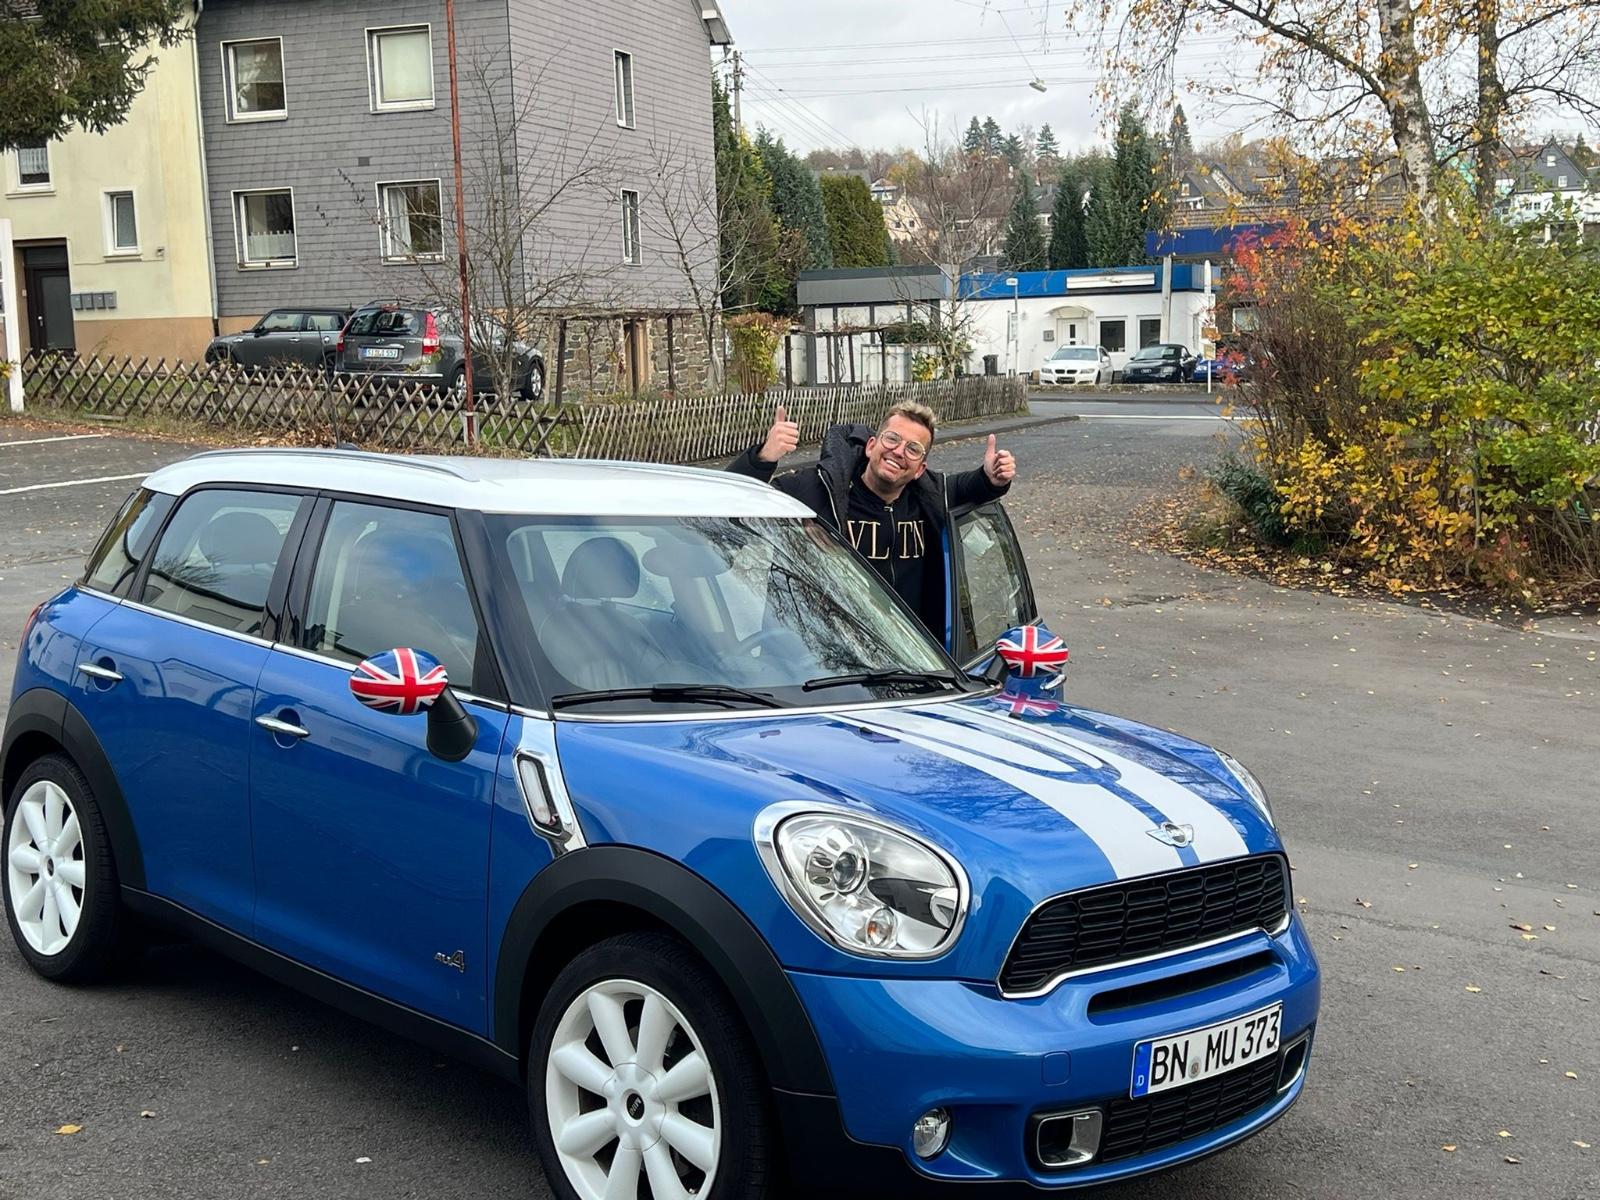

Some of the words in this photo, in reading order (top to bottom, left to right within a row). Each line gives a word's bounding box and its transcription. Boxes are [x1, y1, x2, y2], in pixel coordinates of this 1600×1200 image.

[1151, 1040, 1189, 1086] BN
[1205, 1026, 1238, 1072] MU
[1241, 1011, 1279, 1058] 373
